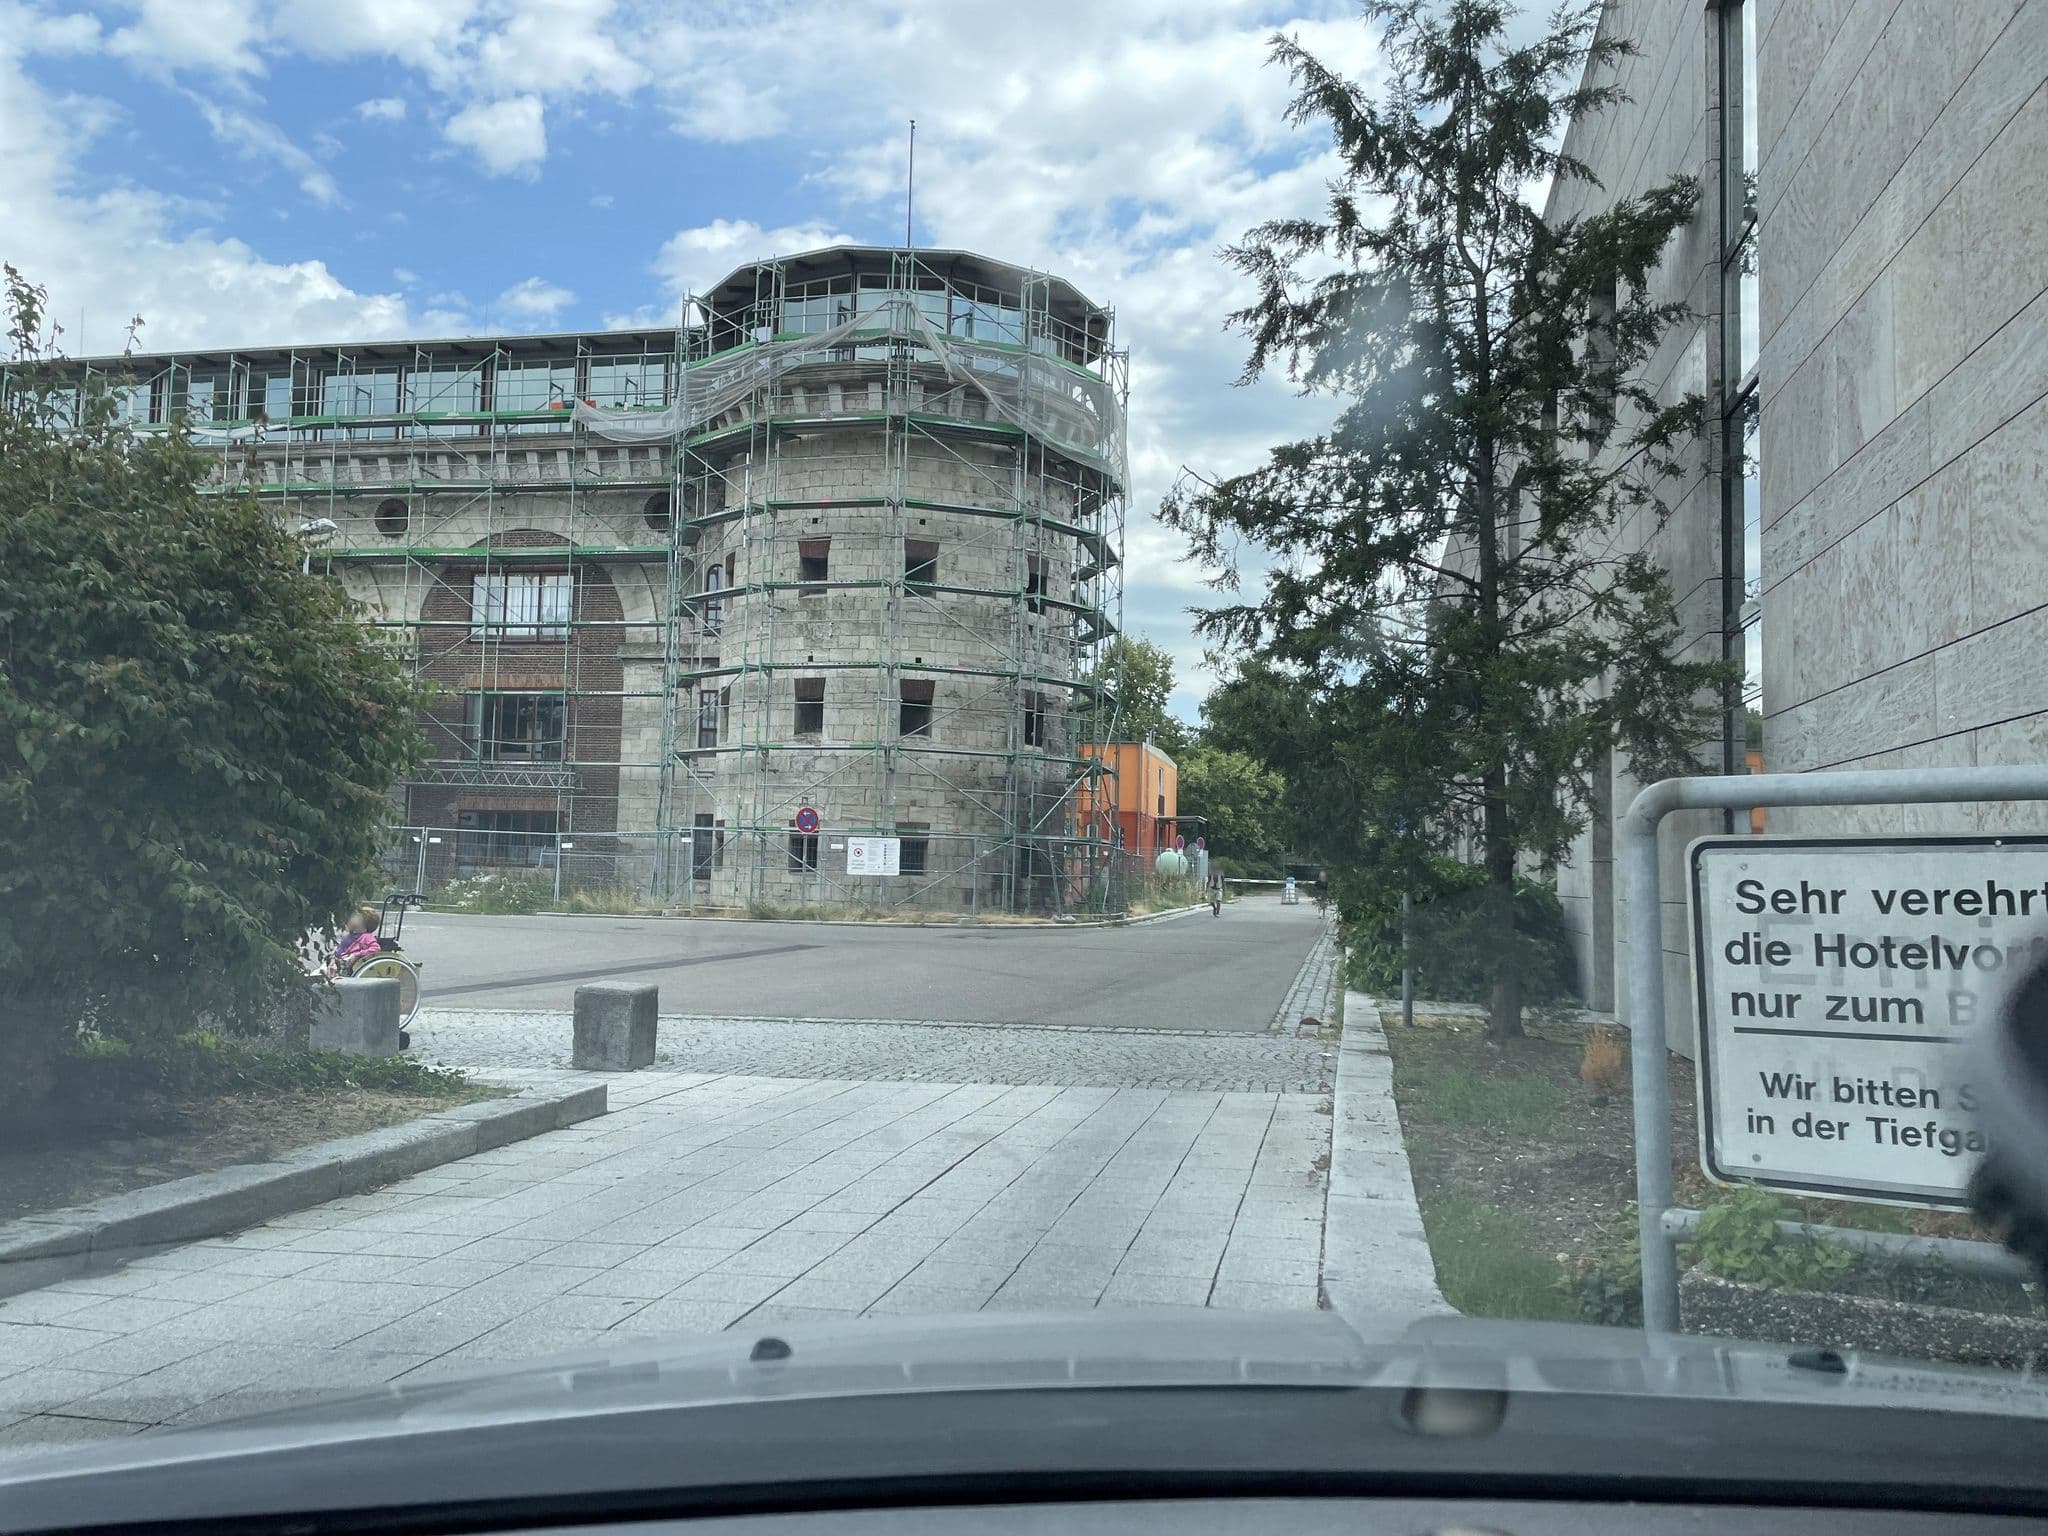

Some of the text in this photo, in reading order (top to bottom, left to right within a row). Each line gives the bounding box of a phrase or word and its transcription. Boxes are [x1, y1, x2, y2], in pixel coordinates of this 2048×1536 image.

[1735, 880, 1846, 915] Sehr
[1725, 932, 1791, 966] die
[1814, 933, 2044, 972] Hotelvor
[1731, 990, 1979, 1026] nur zum B
[1759, 1071, 1816, 1101] Wir
[1833, 1076, 1940, 1109] bitten
[1957, 1083, 1981, 1112] S
[1748, 1108, 1986, 1157] in der Tiefga
